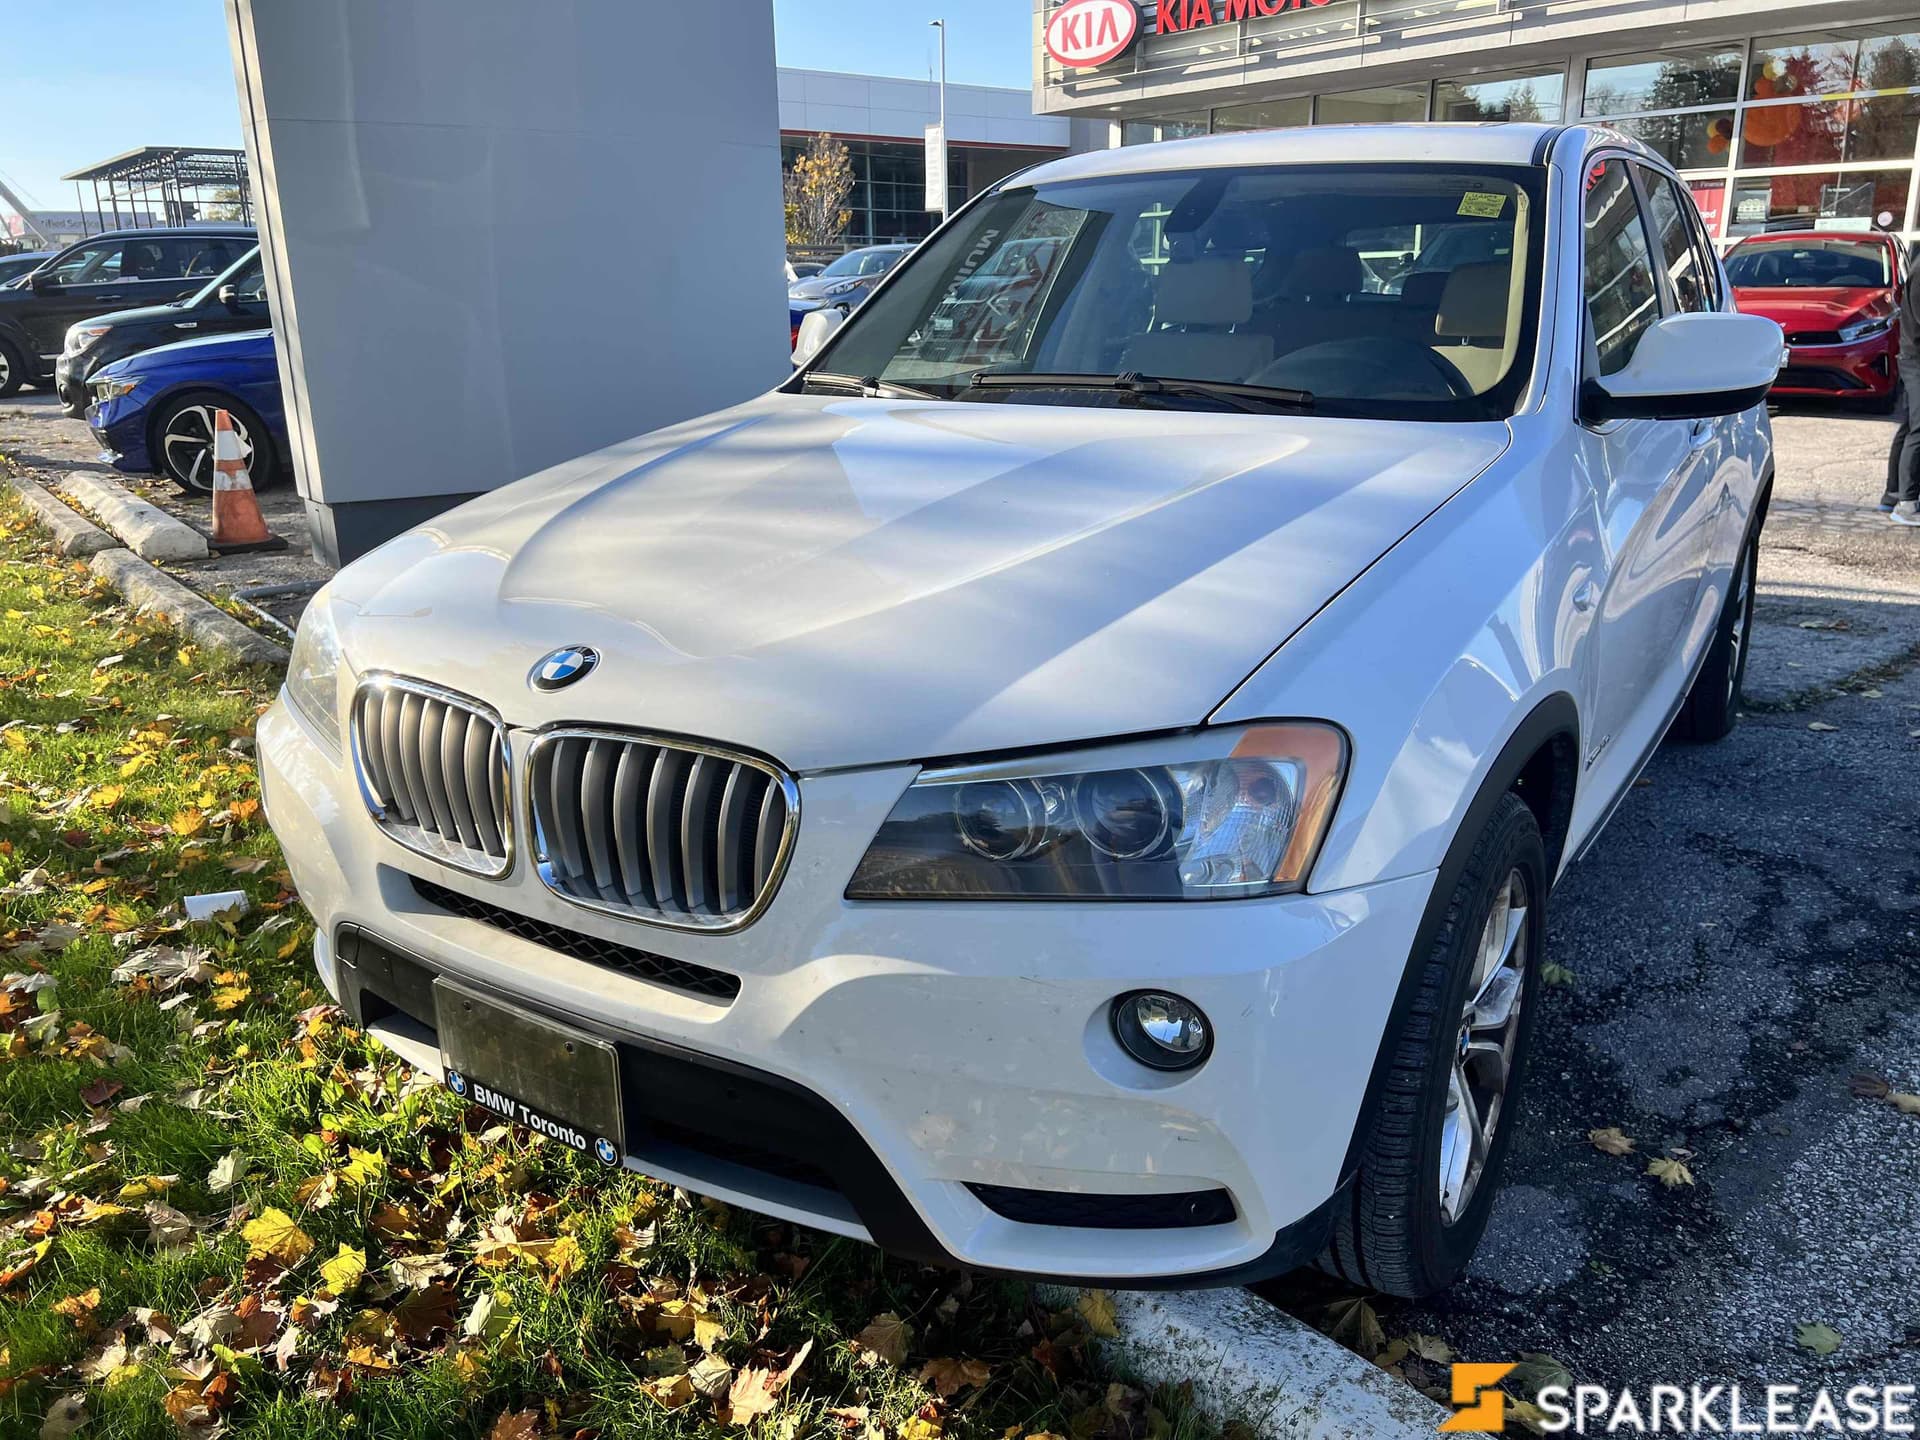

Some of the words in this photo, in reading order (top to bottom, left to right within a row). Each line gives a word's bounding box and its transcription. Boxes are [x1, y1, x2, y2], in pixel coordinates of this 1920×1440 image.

[1061, 7, 1119, 52] KIA
[1156, 0, 1213, 35] KIA
[474, 1084, 514, 1117] BMW
[518, 1104, 586, 1150] Toronto
